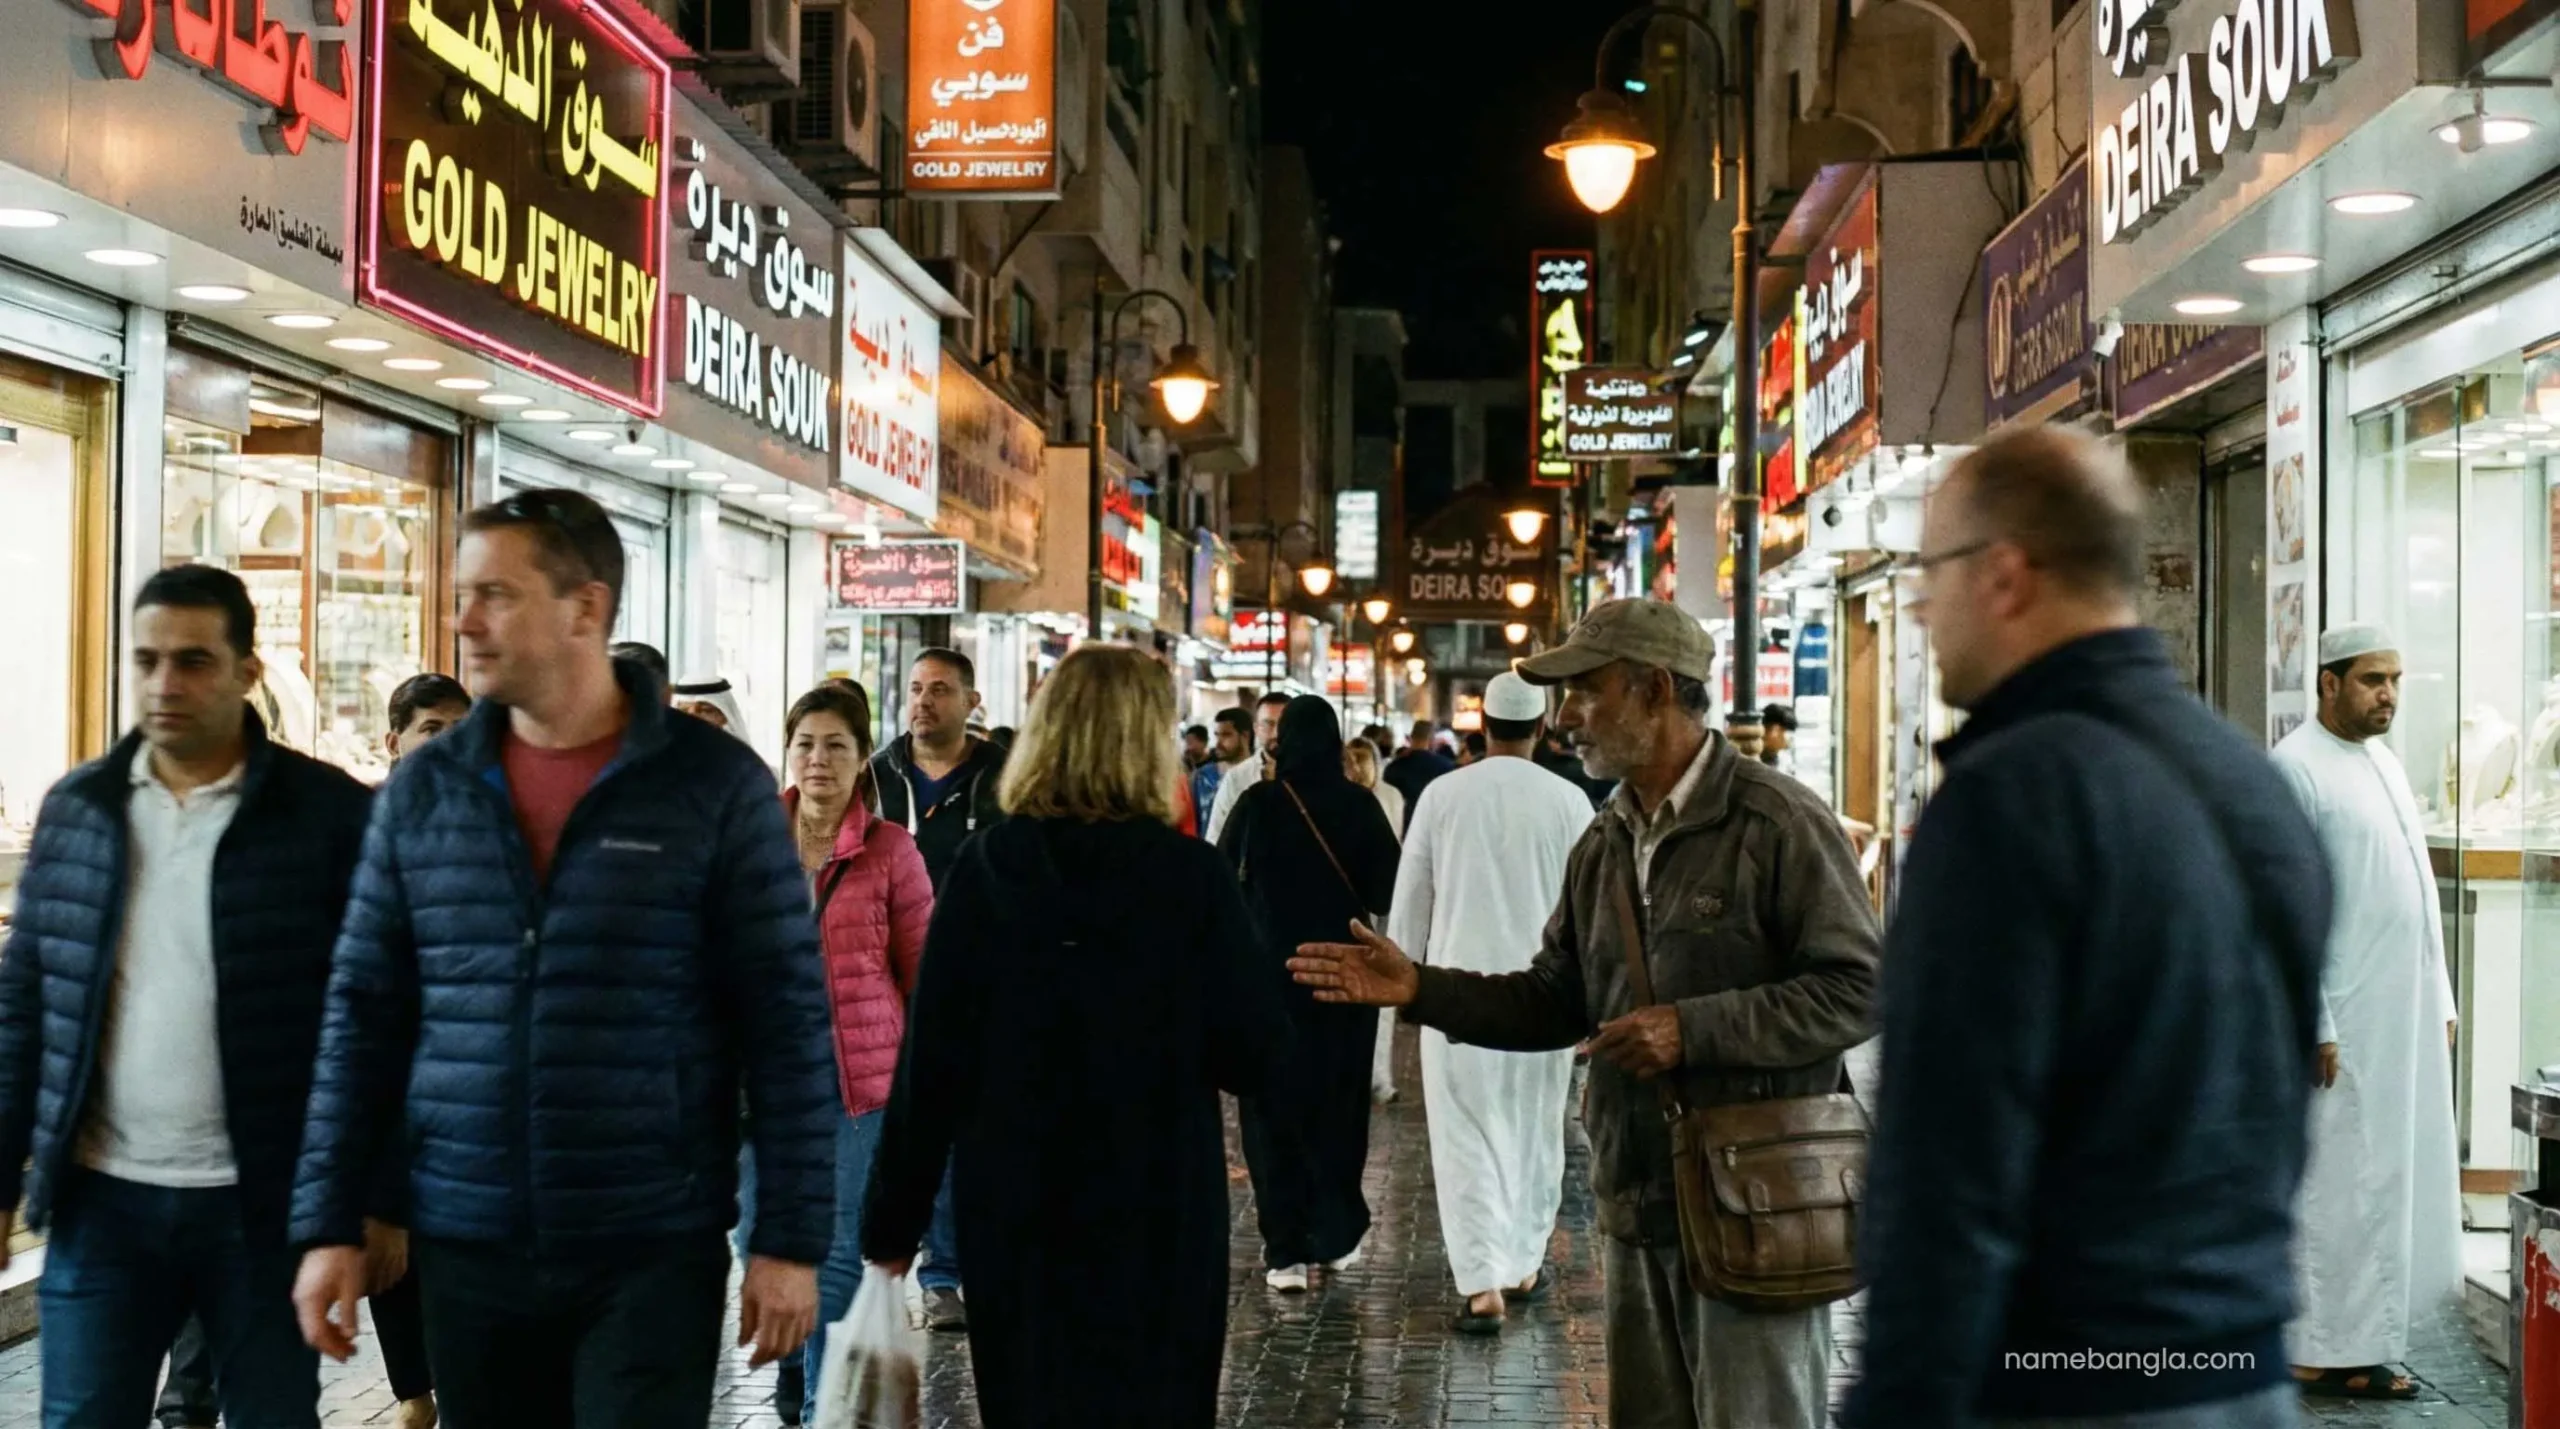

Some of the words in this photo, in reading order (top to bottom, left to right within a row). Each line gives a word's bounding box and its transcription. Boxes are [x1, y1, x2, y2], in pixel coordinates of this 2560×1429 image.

[562, 37, 658, 199] سوق
[912, 161, 961, 178] GOLD
[964, 161, 1047, 178] JEWELRY
[2101, 53, 2199, 245] DEIRA
[2208, 0, 2332, 155] SOUK
[404, 139, 508, 285] GOLD
[517, 205, 658, 359] JEWELRY
[687, 139, 757, 279] ديرة
[764, 205, 834, 319] سوق
[684, 294, 762, 420] DEIRA
[768, 344, 830, 453] SOUK
[847, 397, 881, 469] GOLD
[1569, 433, 1608, 451] GOLD
[1609, 433, 1673, 450] JEWELRY
[1410, 573, 1473, 600] DEIRA
